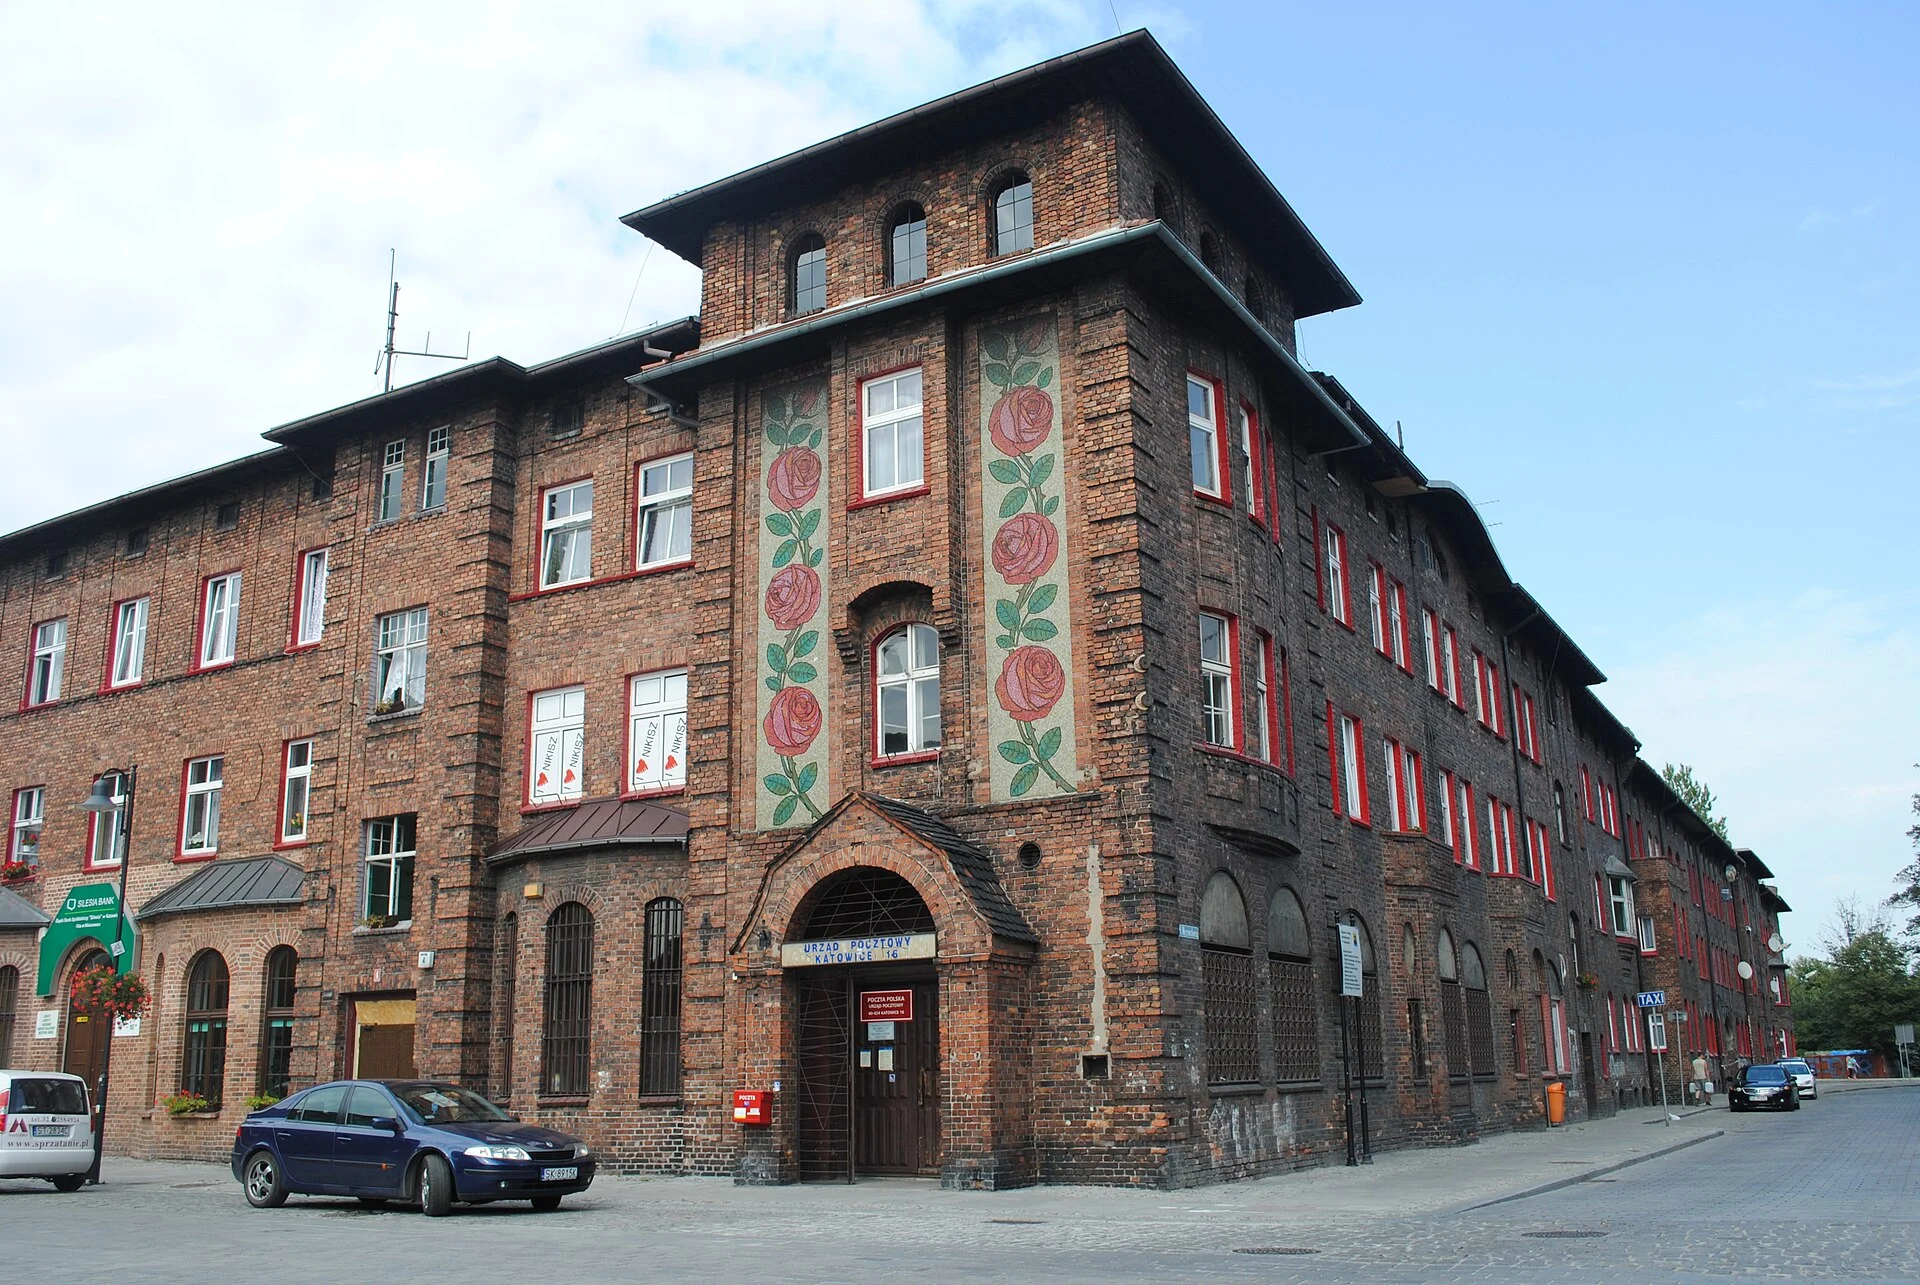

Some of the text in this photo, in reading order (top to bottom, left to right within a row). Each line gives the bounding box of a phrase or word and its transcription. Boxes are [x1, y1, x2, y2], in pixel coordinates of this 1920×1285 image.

[641, 721, 658, 757] NIKISZ
[671, 717, 687, 754] NIKISZ
[542, 736, 558, 771] NIKISZ
[569, 733, 584, 768] NIKISZ
[77, 896, 115, 908] SILESIA BANK
[804, 936, 911, 954] URZĄD POCZTOWY
[815, 949, 898, 964] KATOWICE 16
[1639, 993, 1664, 1005] TAXI
[8, 1139, 89, 1150] www.sprzatanie.pl
[545, 1169, 555, 1179] SK
